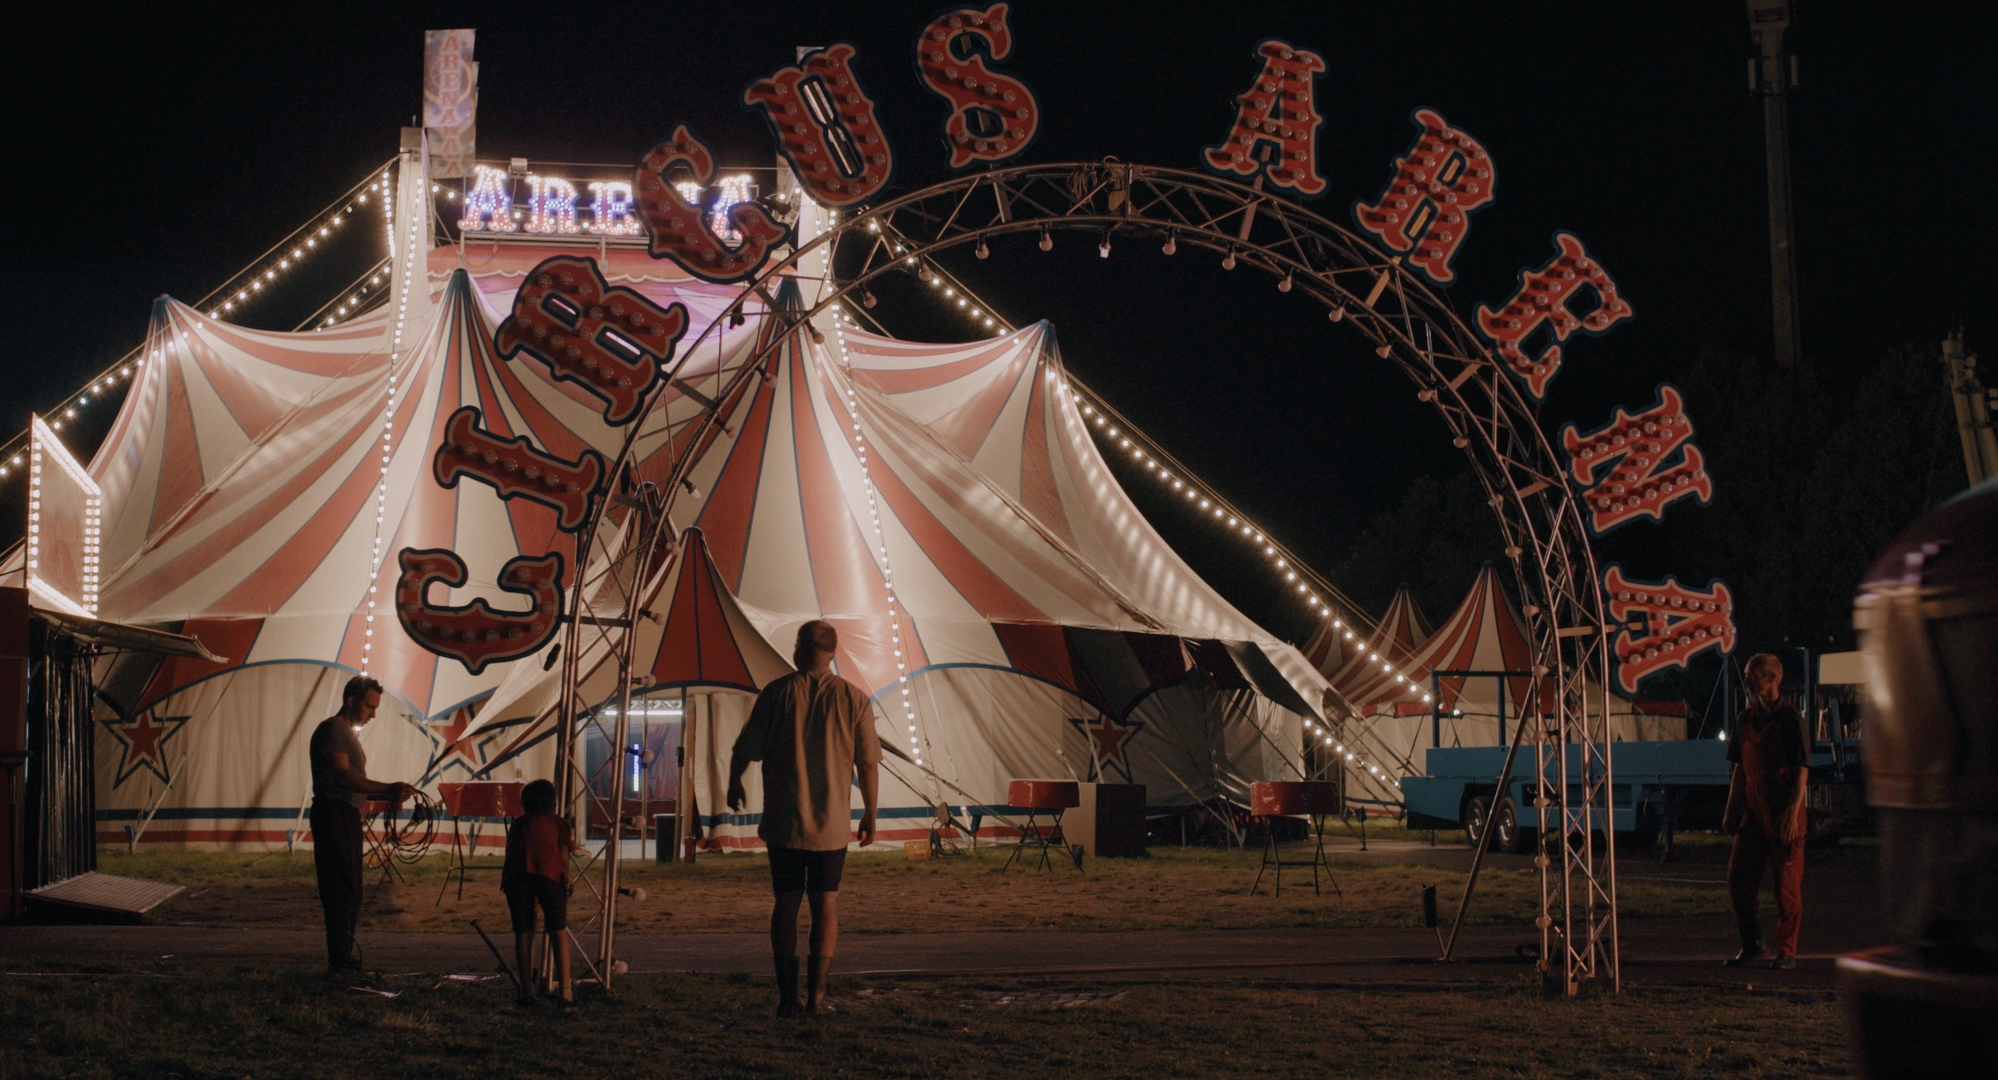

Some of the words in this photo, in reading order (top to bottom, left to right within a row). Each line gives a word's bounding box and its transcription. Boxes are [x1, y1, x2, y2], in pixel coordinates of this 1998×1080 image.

[396, 2, 1040, 674] CIRCUS
[1204, 38, 1738, 696] ARENA
[456, 163, 755, 241] AREA
